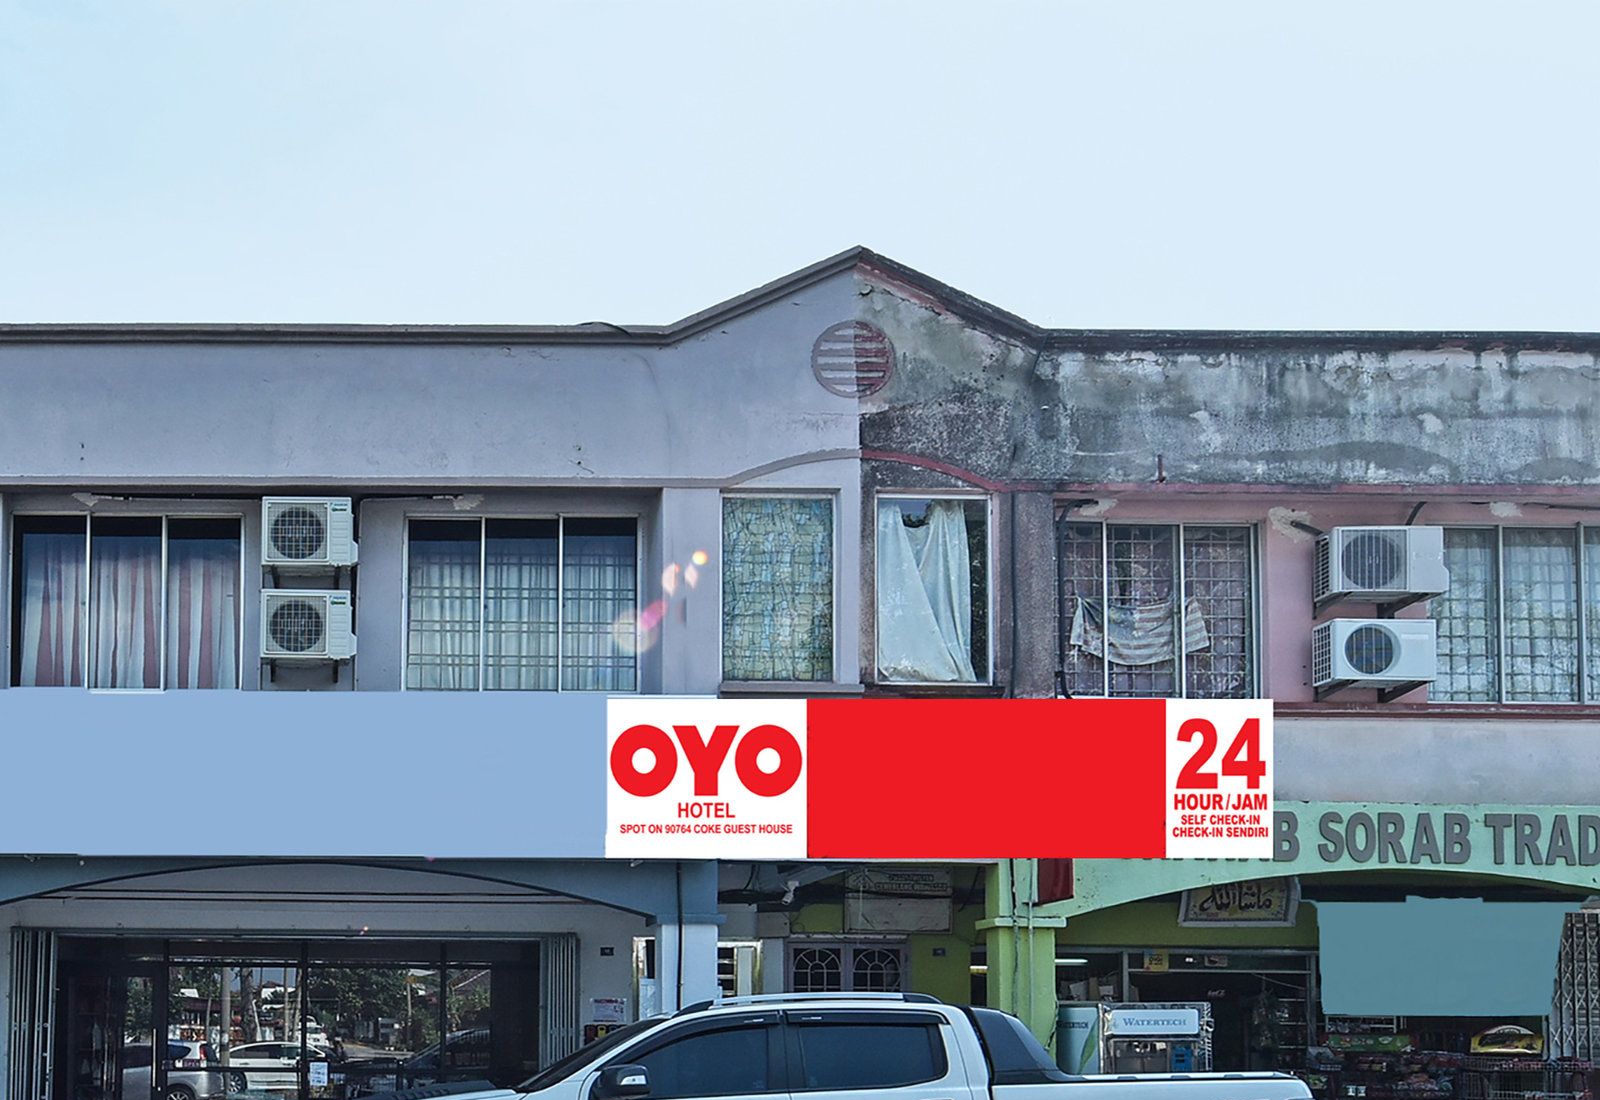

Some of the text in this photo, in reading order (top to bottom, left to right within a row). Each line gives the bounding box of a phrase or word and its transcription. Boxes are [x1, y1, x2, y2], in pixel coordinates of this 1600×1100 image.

[610, 724, 803, 797] OYO
[1176, 718, 1266, 789] 24
[678, 802, 736, 819] HOTEL
[1181, 814, 1261, 825] SELF CHECK-IN
[620, 823, 793, 834] SPOT ON 90764 COKE GUEST HOUSE
[1172, 827, 1269, 838] CHECK-IN SENDIRI
[1318, 811, 1472, 864] SORAB
[1484, 813, 1600, 867] TRAD
